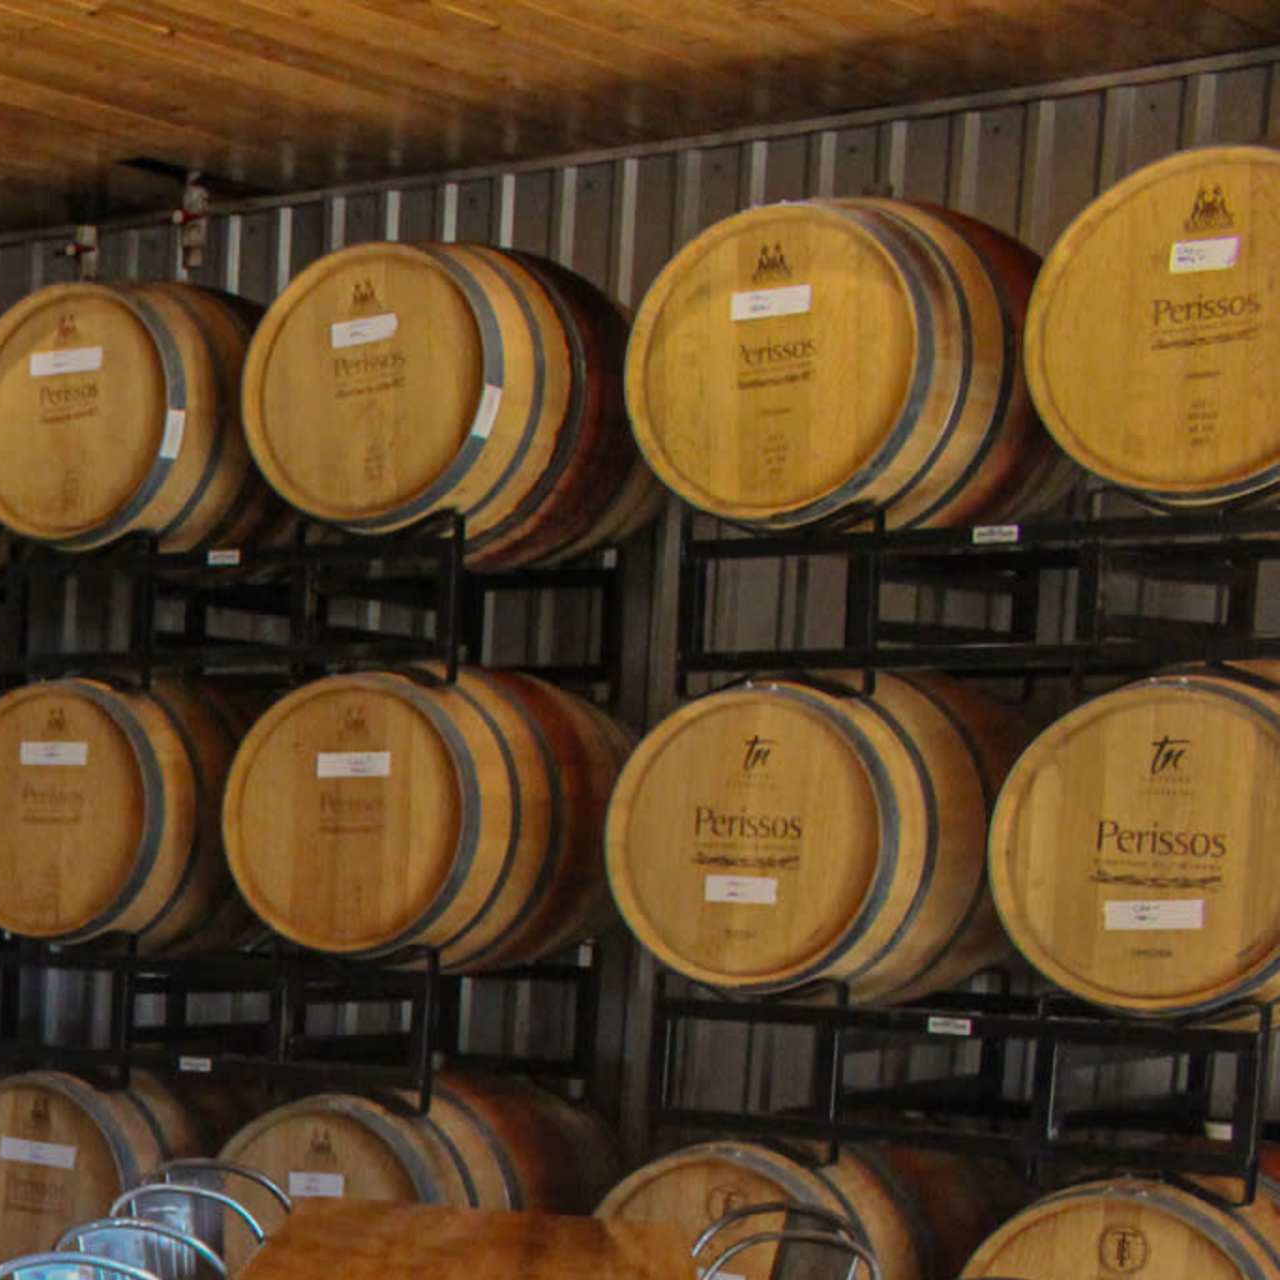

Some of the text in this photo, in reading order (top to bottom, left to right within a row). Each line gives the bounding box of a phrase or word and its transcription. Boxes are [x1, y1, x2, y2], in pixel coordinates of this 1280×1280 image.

[1152, 292, 1262, 325] Perissos
[693, 804, 803, 840] Perissos
[1096, 818, 1228, 859] Perissos
